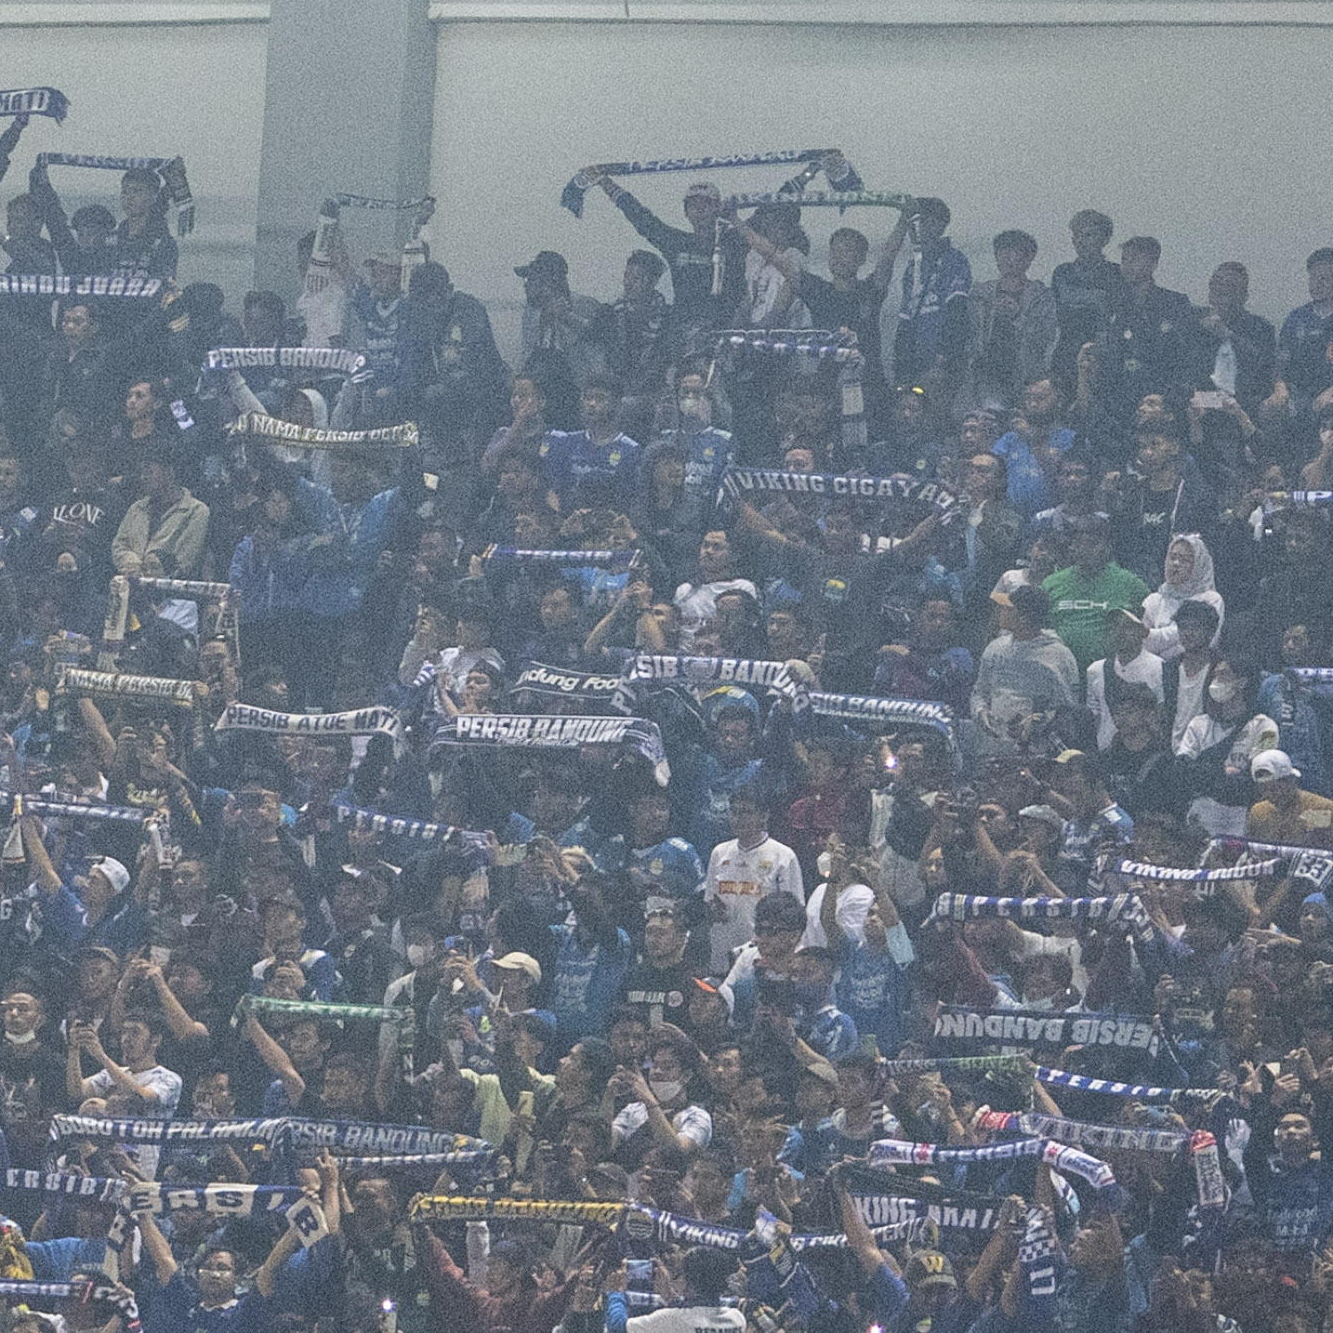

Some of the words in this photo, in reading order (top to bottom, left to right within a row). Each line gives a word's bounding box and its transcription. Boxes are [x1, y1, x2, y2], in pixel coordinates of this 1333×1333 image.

[208, 347, 276, 368] PERSIB
[737, 472, 825, 493] VIKING
[227, 705, 290, 729] PERSIB
[456, 717, 529, 740] PERSIB
[291, 1120, 339, 1147] RSIB
[130, 1189, 321, 1239] ERSIB
[854, 1196, 918, 1224] KING
